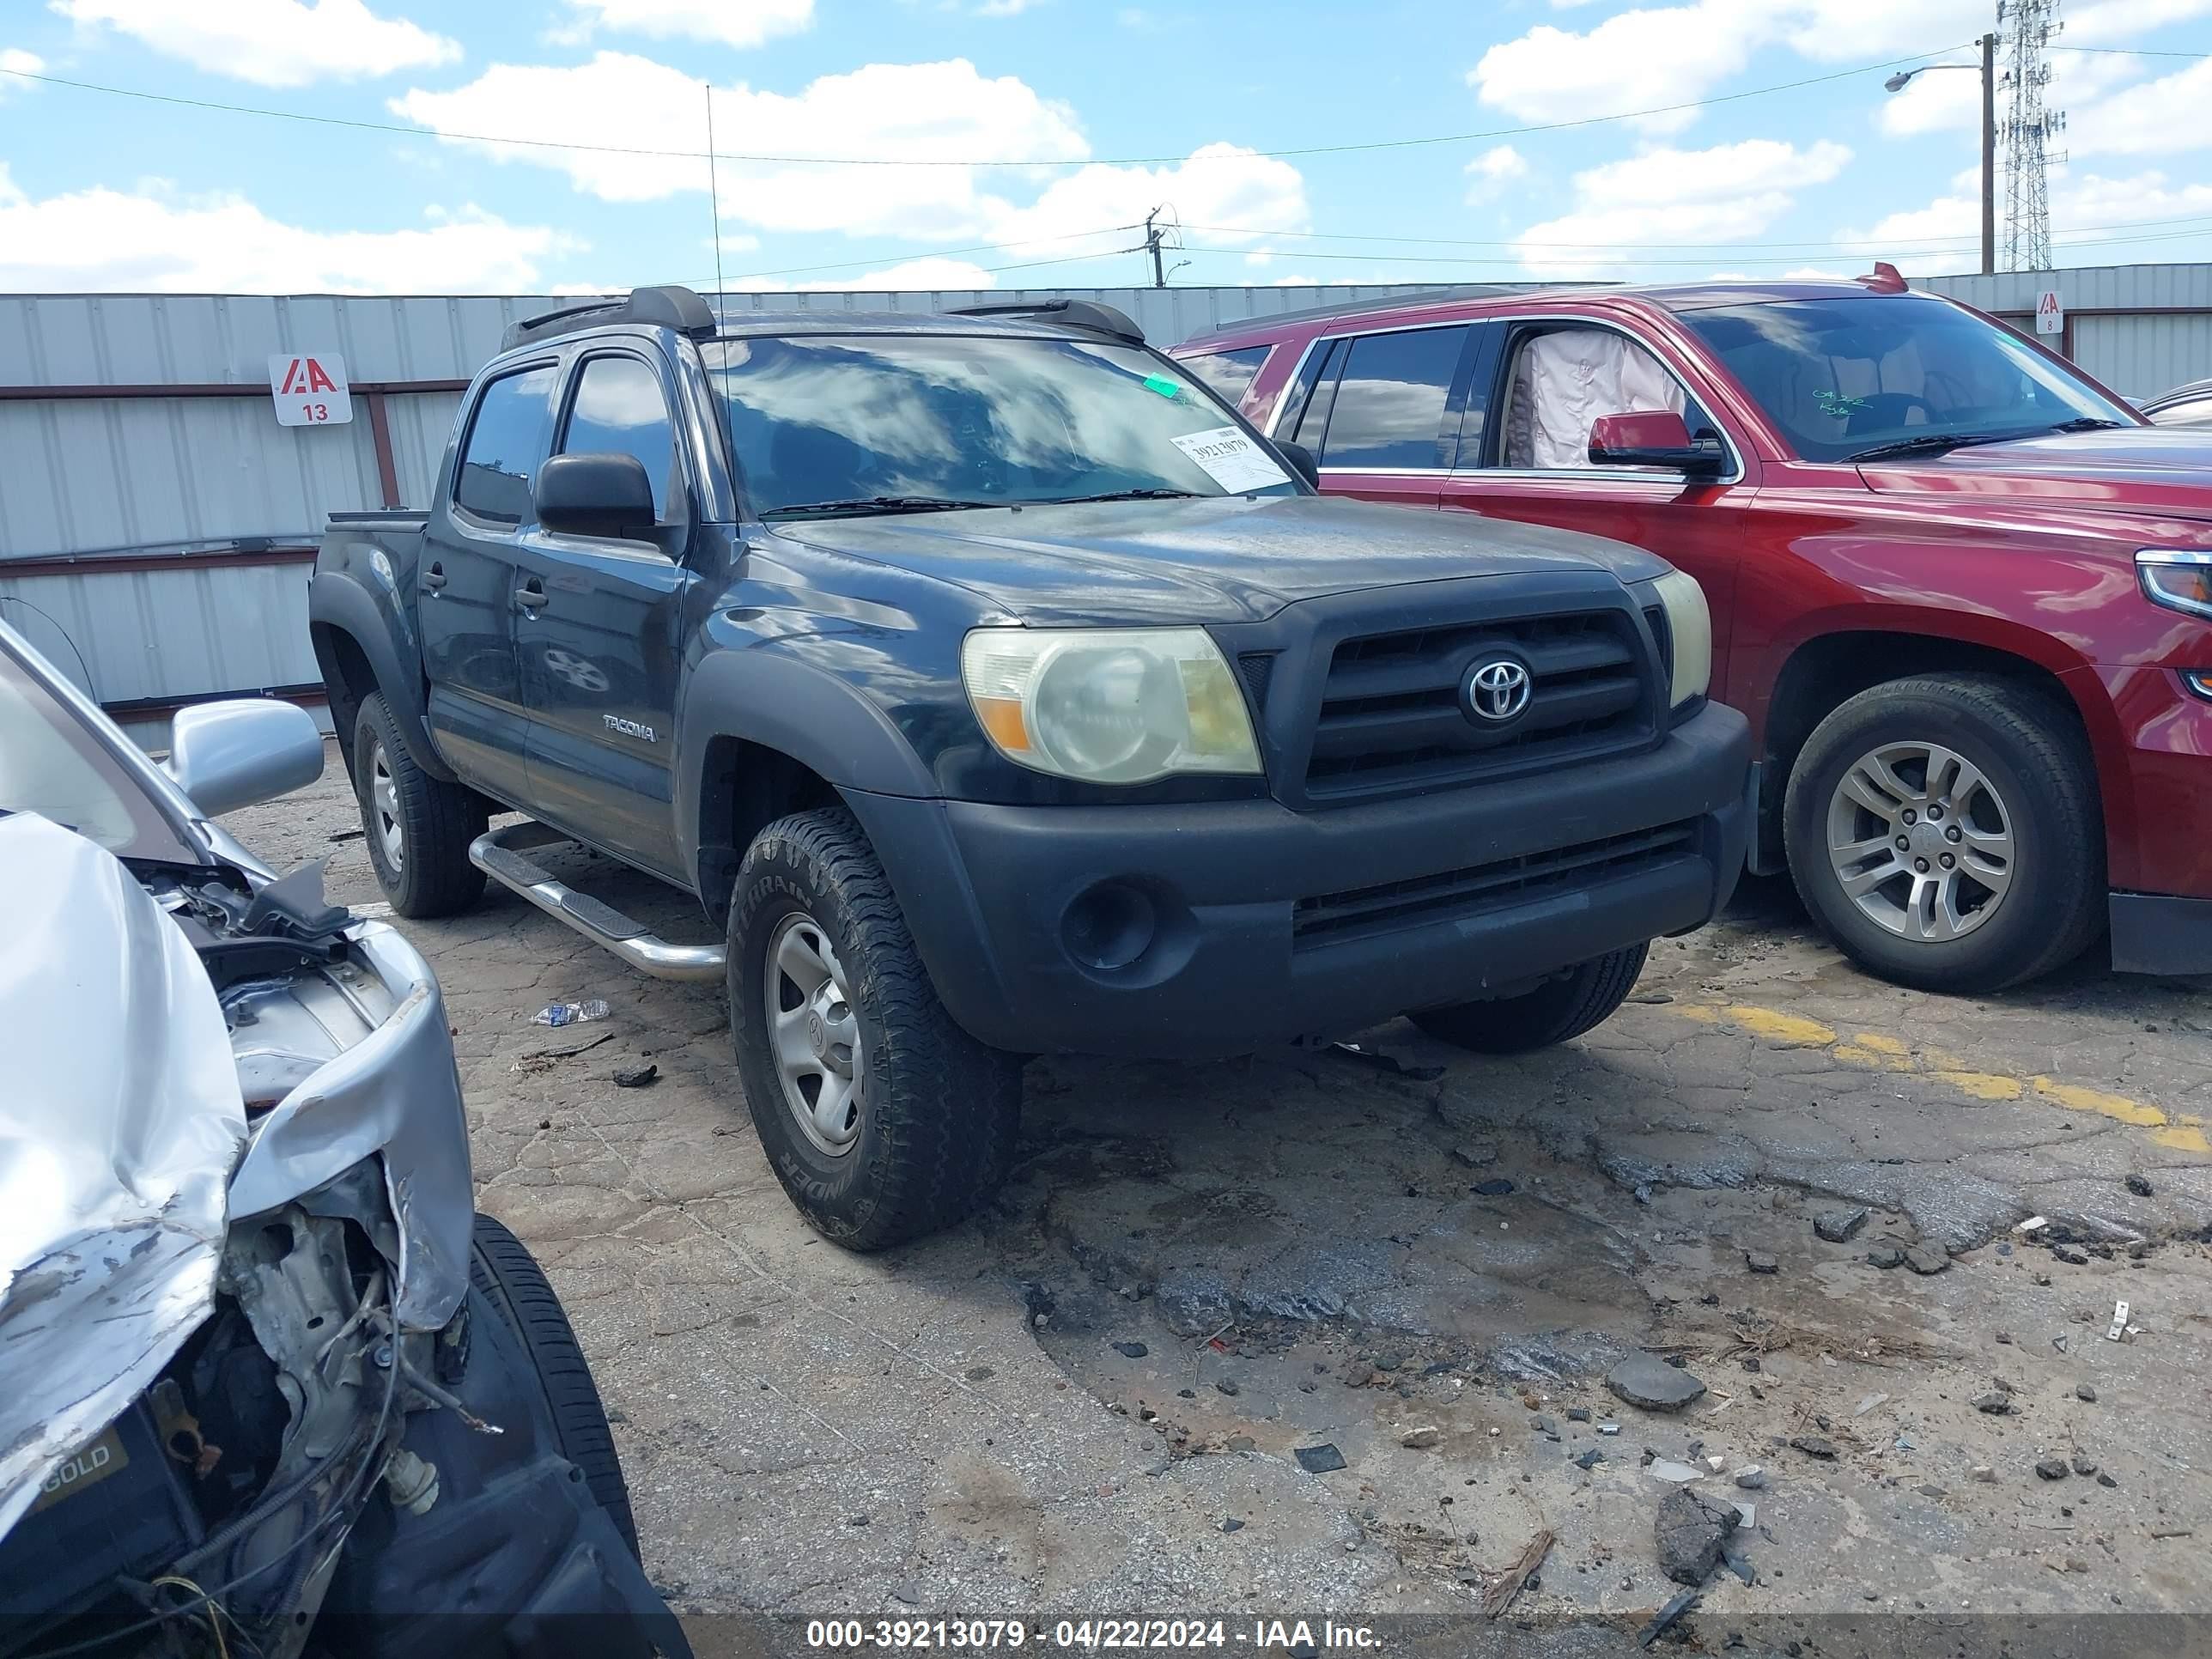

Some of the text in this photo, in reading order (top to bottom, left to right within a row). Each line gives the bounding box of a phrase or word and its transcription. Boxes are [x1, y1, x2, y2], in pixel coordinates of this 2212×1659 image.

[302, 404, 328, 422] 13
[1193, 439, 1249, 460] 39213079
[603, 714, 657, 743] TACOMA
[44, 1445, 110, 1493] GOLD
